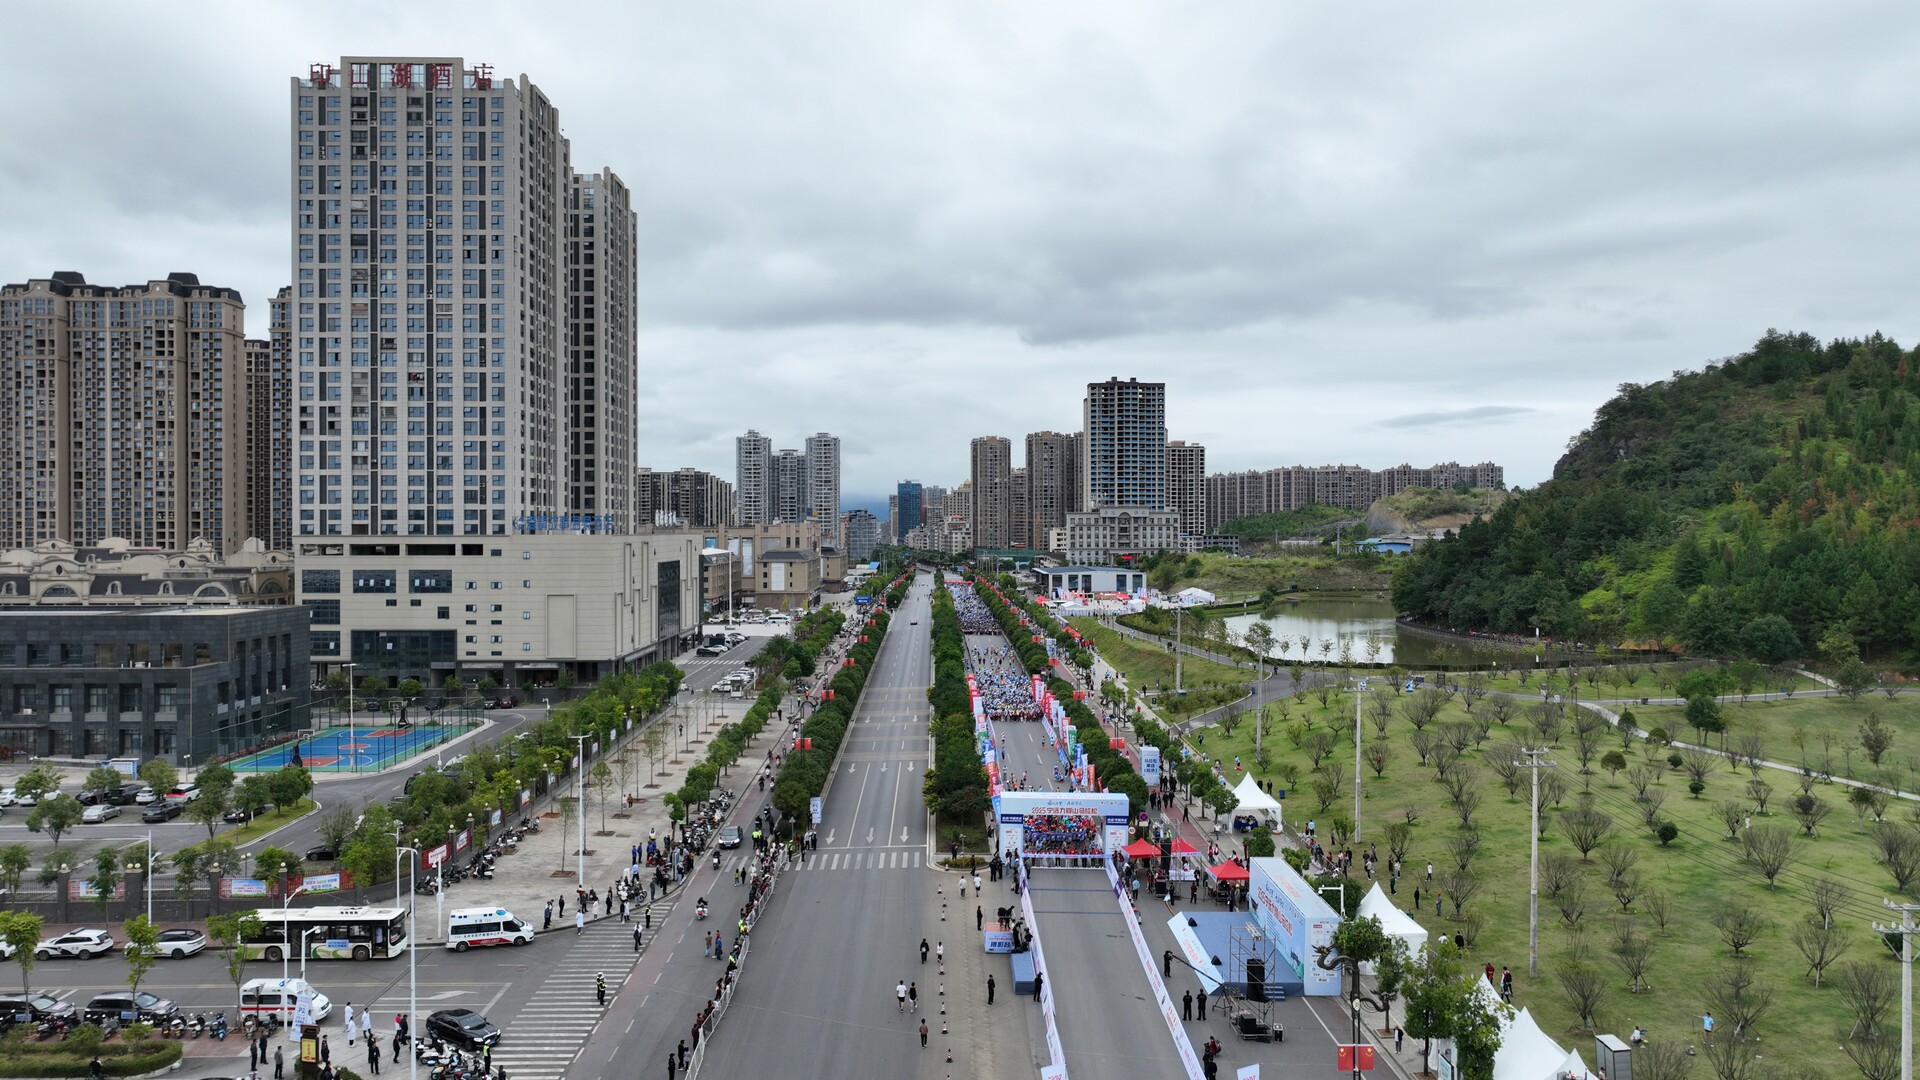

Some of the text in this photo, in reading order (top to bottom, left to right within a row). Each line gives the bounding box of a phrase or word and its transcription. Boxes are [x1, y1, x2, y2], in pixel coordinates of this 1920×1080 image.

[309, 62, 495, 89] 印山湖酒店
